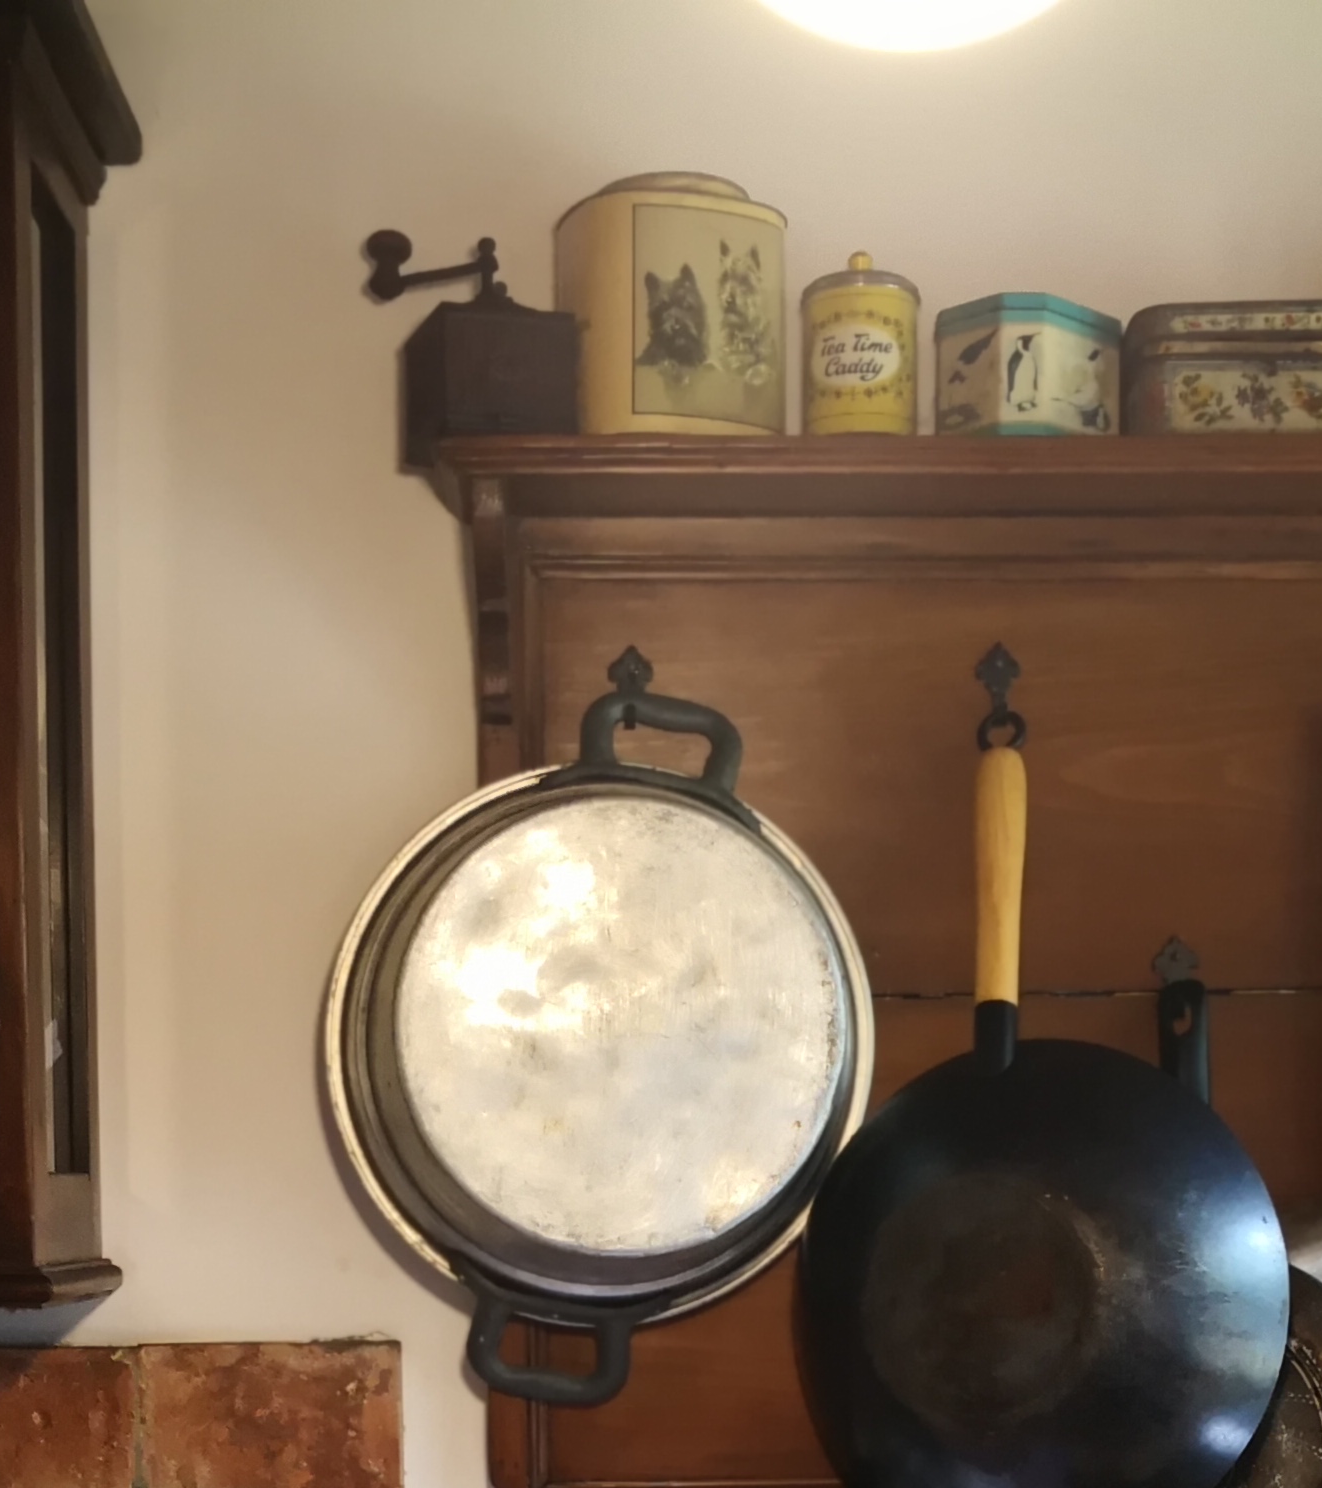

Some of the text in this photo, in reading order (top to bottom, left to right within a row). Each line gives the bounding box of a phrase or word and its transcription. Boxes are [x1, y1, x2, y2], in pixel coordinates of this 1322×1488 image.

[820, 333, 893, 357] Tea Time
[824, 356, 884, 381] Caddy
